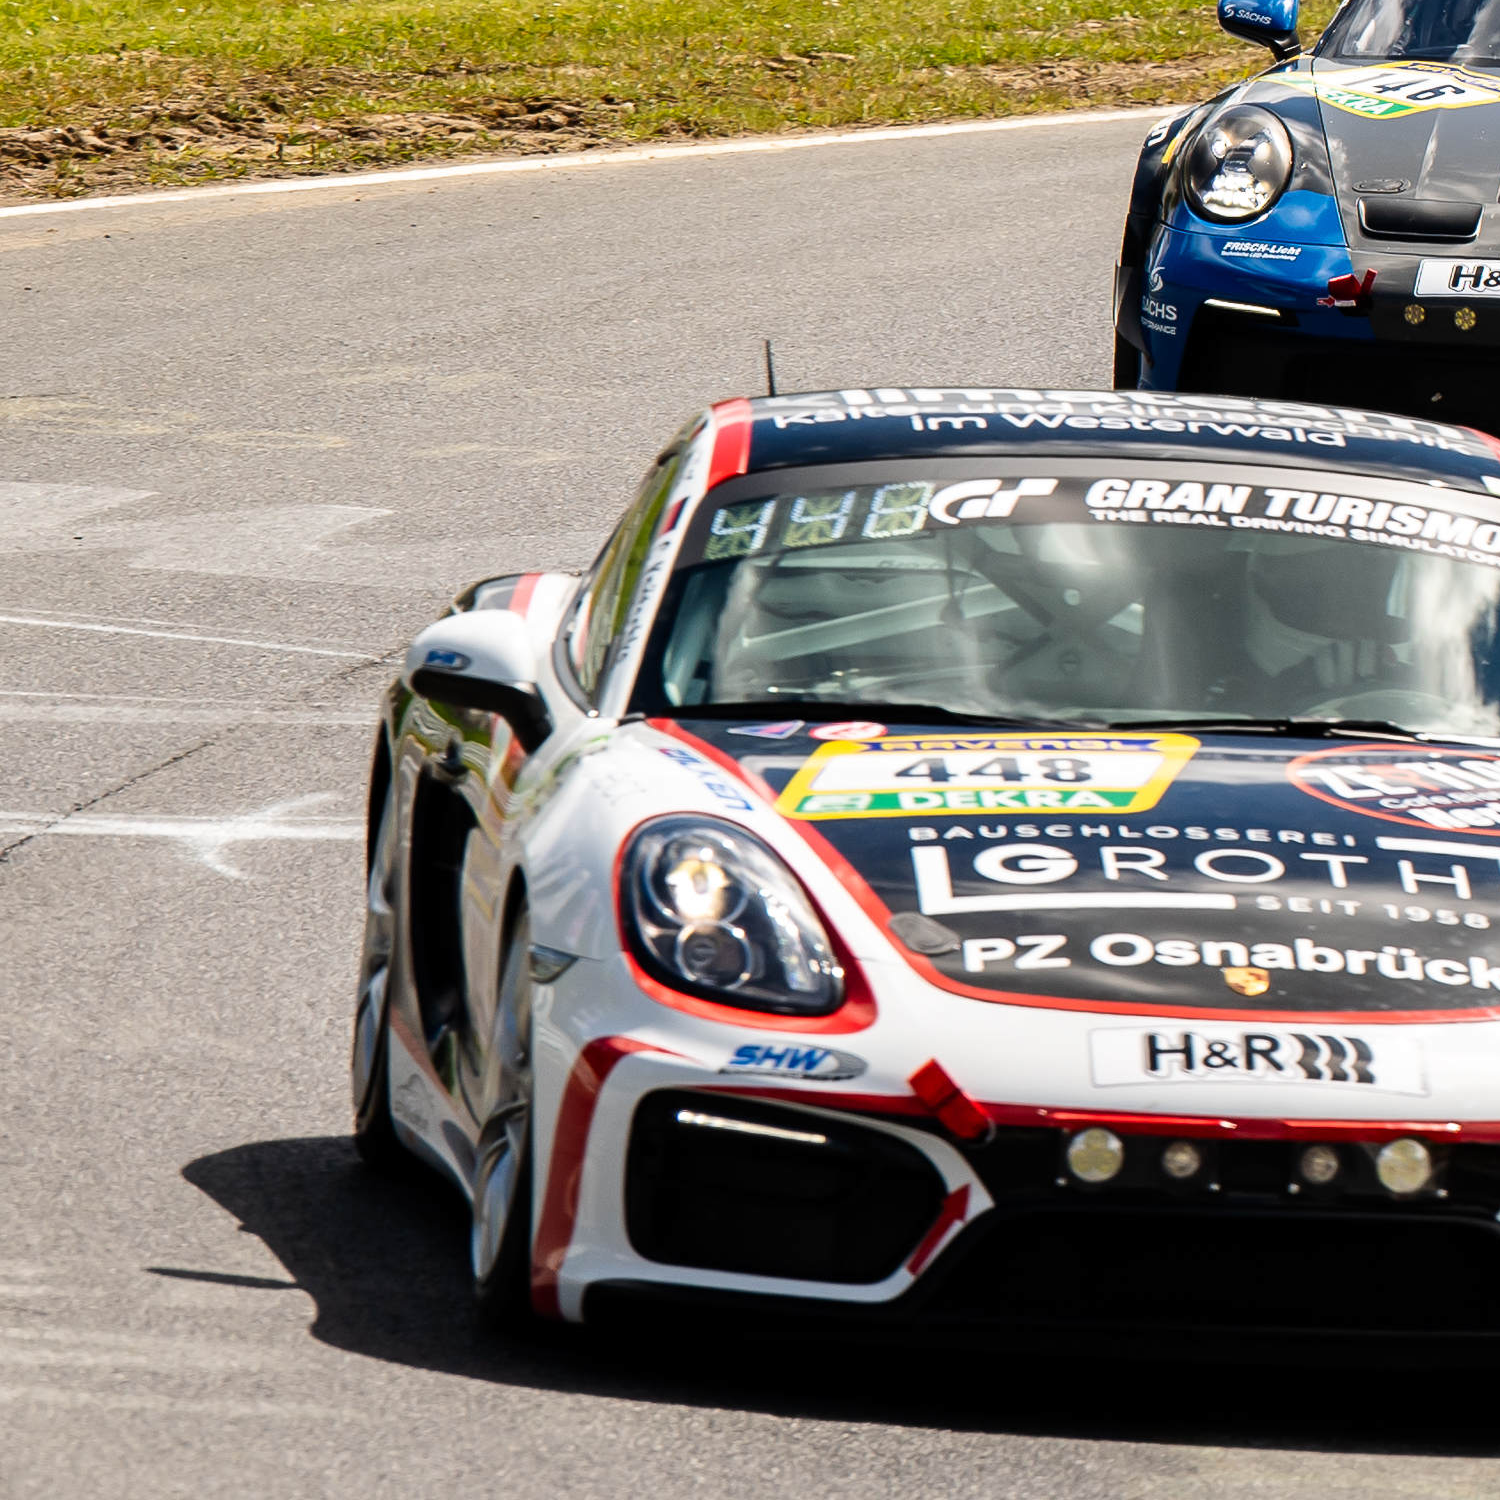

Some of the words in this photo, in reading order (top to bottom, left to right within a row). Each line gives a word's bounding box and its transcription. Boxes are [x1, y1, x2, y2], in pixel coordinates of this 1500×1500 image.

[1236, 9, 1273, 25] SACHS
[1223, 241, 1302, 256] FRISCH-Licht
[957, 401, 1073, 416] und
[999, 412, 1348, 448] Westerwald
[1085, 478, 1253, 514] GRAN
[1089, 509, 1148, 523] THE
[1153, 511, 1228, 527] REAL
[1231, 515, 1346, 539] DRIVING
[894, 756, 1093, 783] 448
[897, 790, 1116, 810] DEKRA
[908, 823, 1356, 848] BAUSCHLOSSEREI
[973, 842, 1472, 900] GROTH
[1255, 894, 1361, 917] SEIT
[1382, 903, 1491, 931] 1958
[962, 933, 1071, 973] PZ
[729, 1044, 831, 1072] SHW
[1145, 1032, 1286, 1073] H&R
